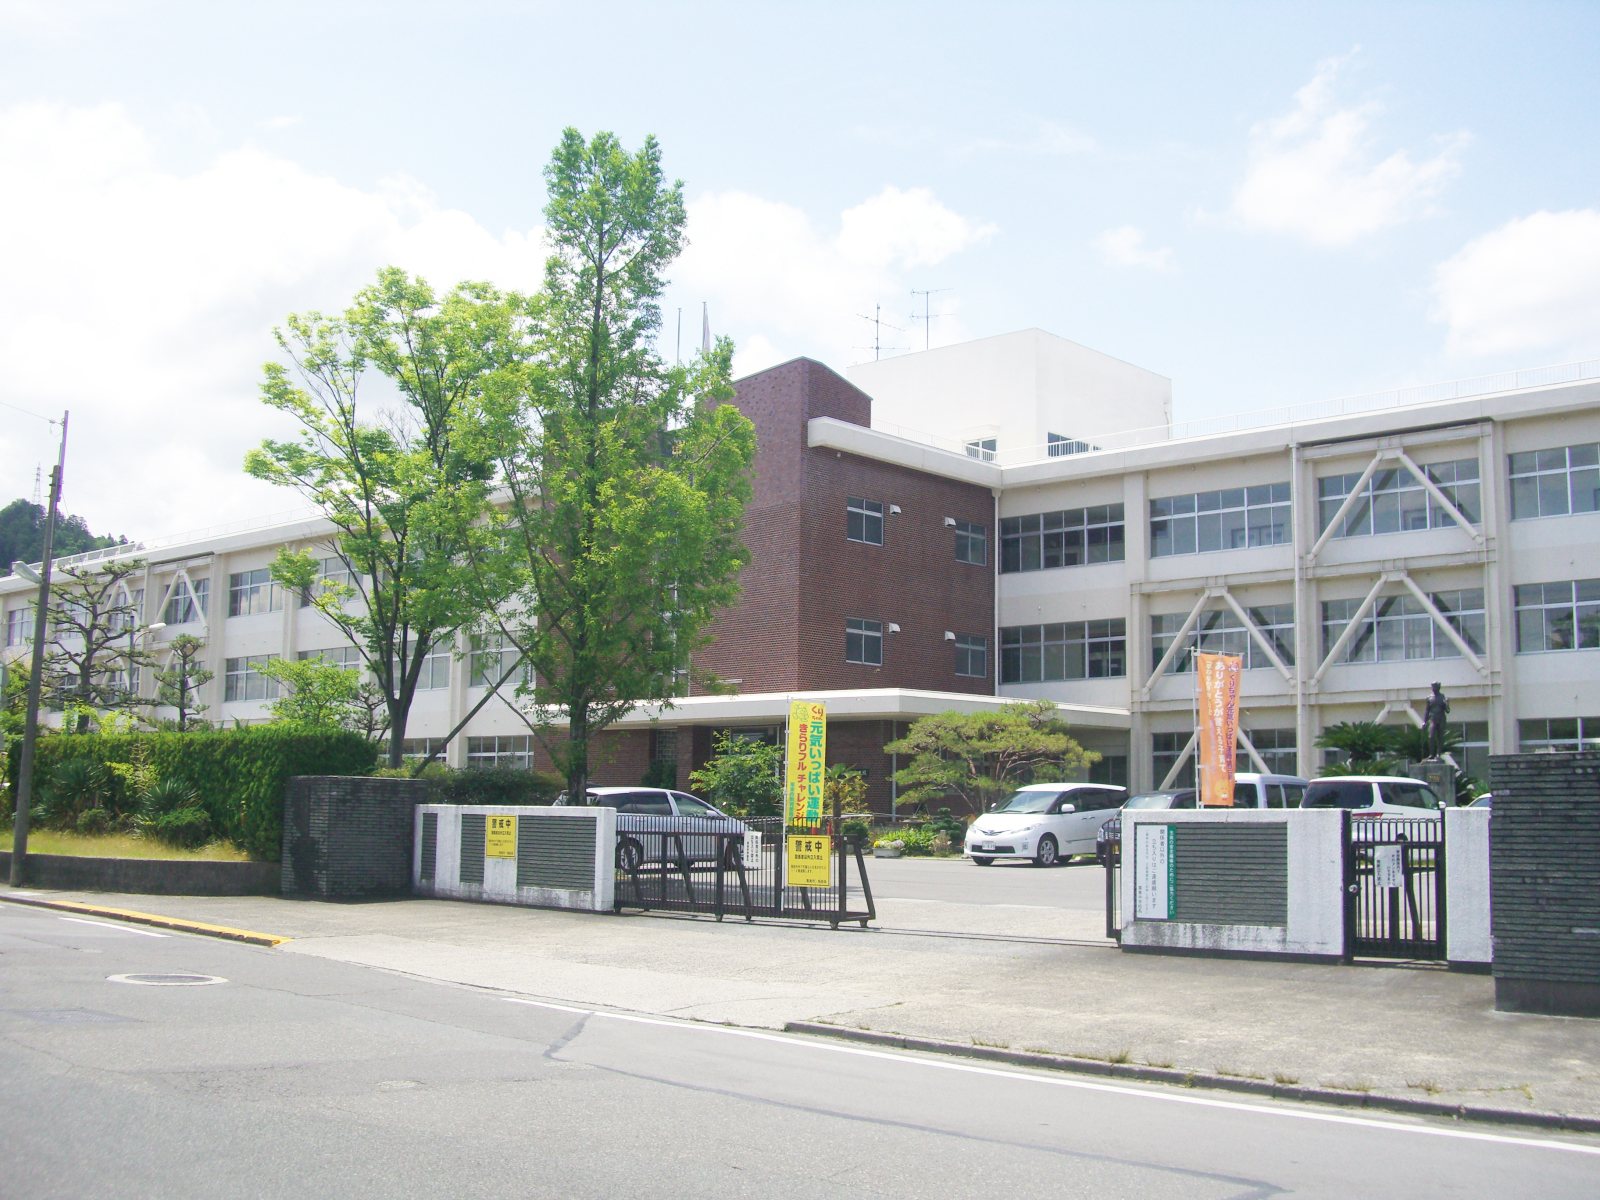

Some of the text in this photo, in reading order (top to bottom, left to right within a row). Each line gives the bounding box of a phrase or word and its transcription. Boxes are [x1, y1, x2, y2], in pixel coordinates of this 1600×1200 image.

[811, 705, 824, 717] くり
[1213, 661, 1226, 773] ありがとうが言える子育て
[806, 721, 823, 822] 元気いっぱい運動
[491, 818, 512, 829] 警戒中
[795, 840, 823, 852] 警戒中
